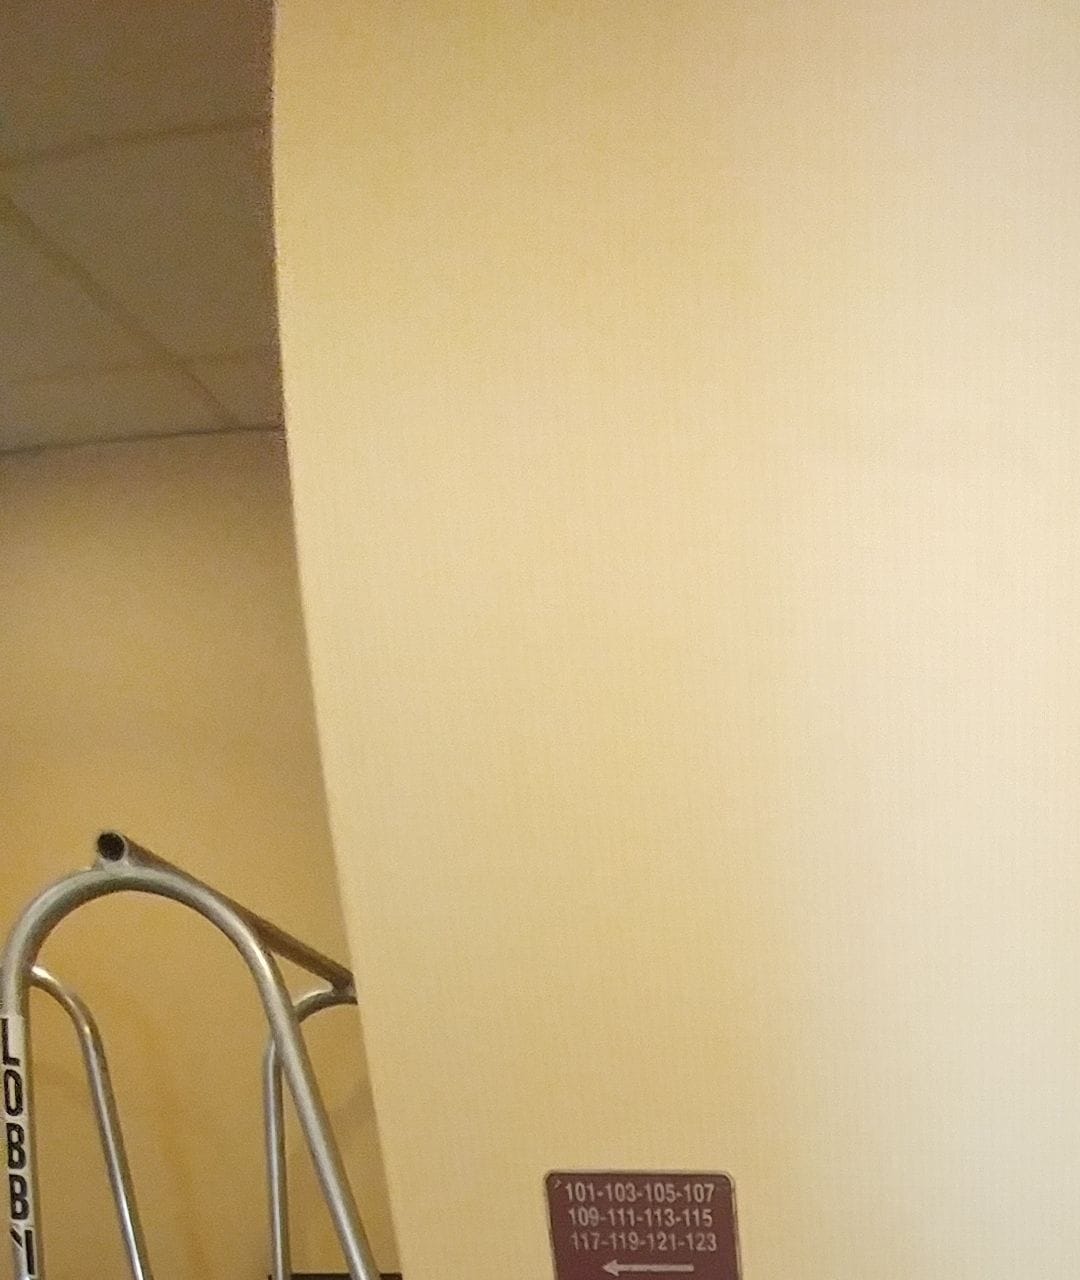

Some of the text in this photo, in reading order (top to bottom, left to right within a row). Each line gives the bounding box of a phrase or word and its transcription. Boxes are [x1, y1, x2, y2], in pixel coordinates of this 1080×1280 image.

[565, 1182, 715, 1202] 101-103-105-107
[568, 1207, 713, 1227] 109-111-113-115
[571, 1232, 717, 1251] 117-119-121-123
